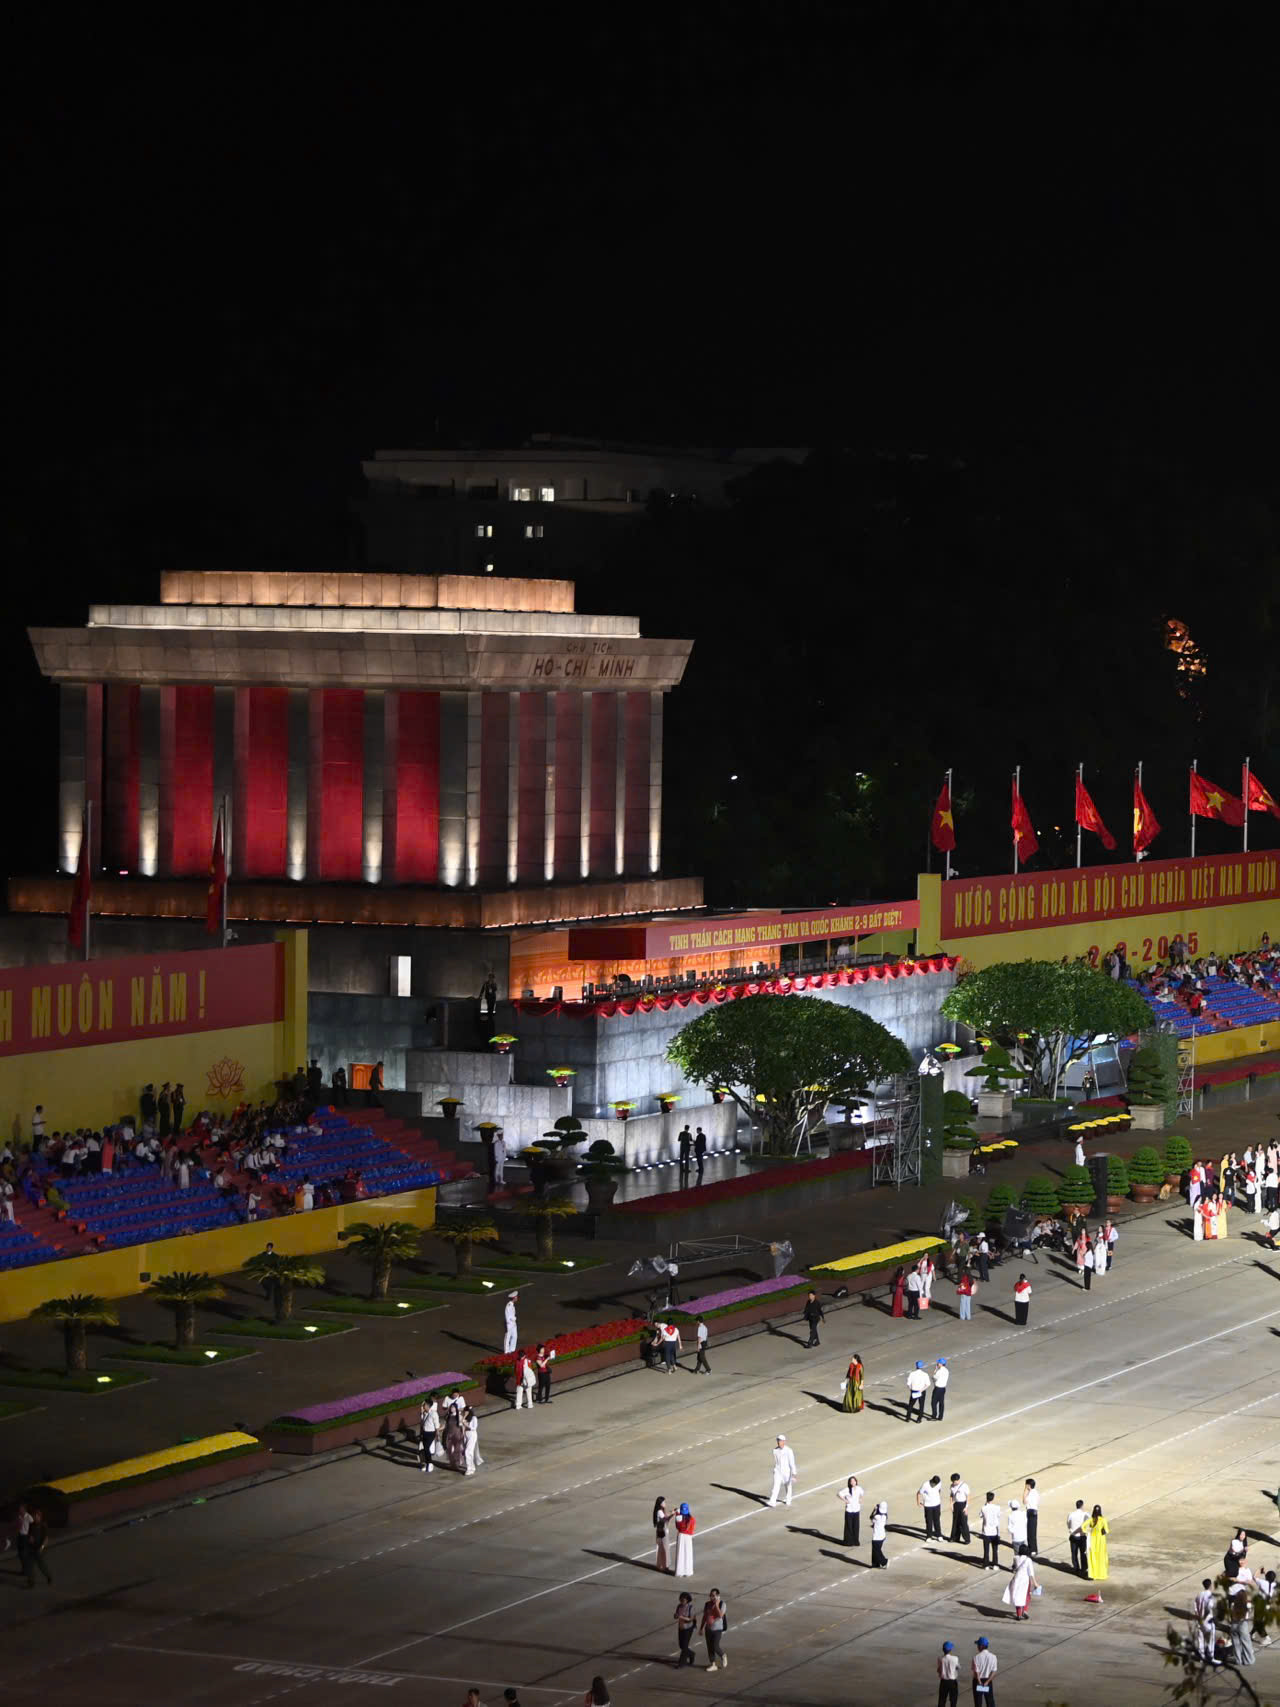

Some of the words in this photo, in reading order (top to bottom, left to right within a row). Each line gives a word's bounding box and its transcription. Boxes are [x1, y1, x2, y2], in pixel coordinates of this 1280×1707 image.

[954, 884, 992, 928] NƯỚC
[999, 880, 1035, 928] CỘNG
[1041, 877, 1066, 917] HÒA
[1072, 874, 1088, 914] XÃ
[1094, 872, 1115, 916] HỘI
[1121, 866, 1145, 908] CHỦ
[1150, 866, 1186, 904] NGHĨA
[1191, 862, 1216, 904] VIỆT
[1219, 863, 1243, 897] NAM
[1247, 856, 1277, 893] MUÔN
[669, 934, 689, 951] TINH
[713, 927, 733, 946] CÁCH
[735, 926, 756, 946] MẠNG
[757, 921, 782, 941] THÁNG
[783, 920, 799, 938] TÁM
[800, 918, 810, 936] VÀ
[811, 915, 829, 936] QUỐC
[830, 914, 854, 933] KHÁNH
[855, 914, 868, 930] 2-9
[869, 908, 883, 929] BẤT
[31, 971, 113, 1039] MUÔN
